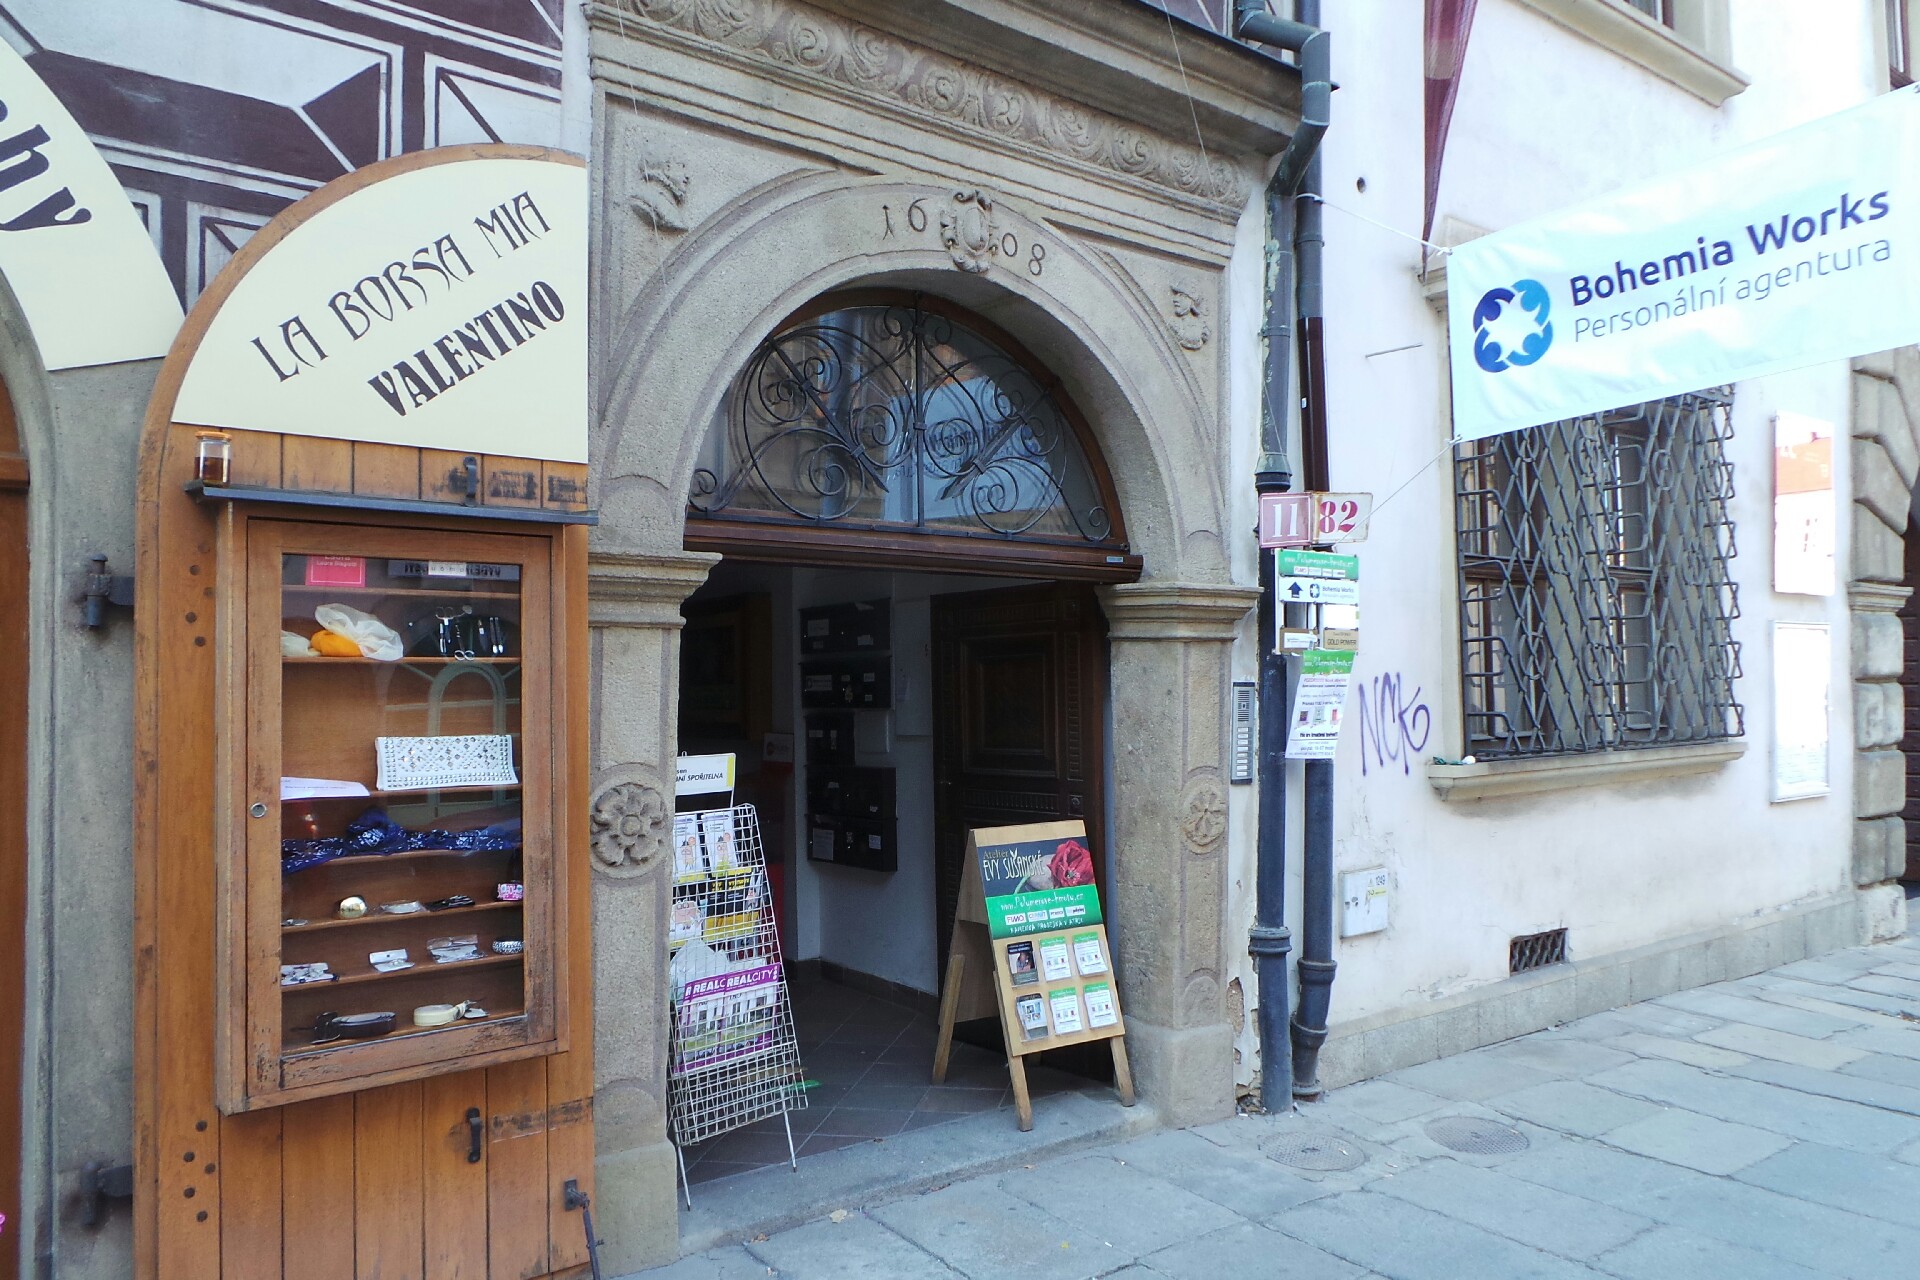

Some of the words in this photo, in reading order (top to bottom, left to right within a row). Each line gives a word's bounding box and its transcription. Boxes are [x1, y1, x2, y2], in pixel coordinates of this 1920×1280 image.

[0, 99, 92, 232] hy
[1570, 236, 1734, 307] Bohemia
[1746, 190, 1890, 256] Works
[250, 315, 328, 383] LA
[327, 233, 476, 342] BORSA
[473, 191, 552, 259] MIA
[1574, 276, 1726, 343] Personální
[1735, 237, 1891, 301] agentura
[367, 280, 565, 417] VALENTINO
[1272, 503, 1299, 538] 11
[1319, 500, 1358, 535] 82
[983, 849, 1009, 860] Atelier
[983, 859, 1001, 882] EVY
[693, 978, 727, 995] REALC
[726, 970, 774, 988] REALCITY
